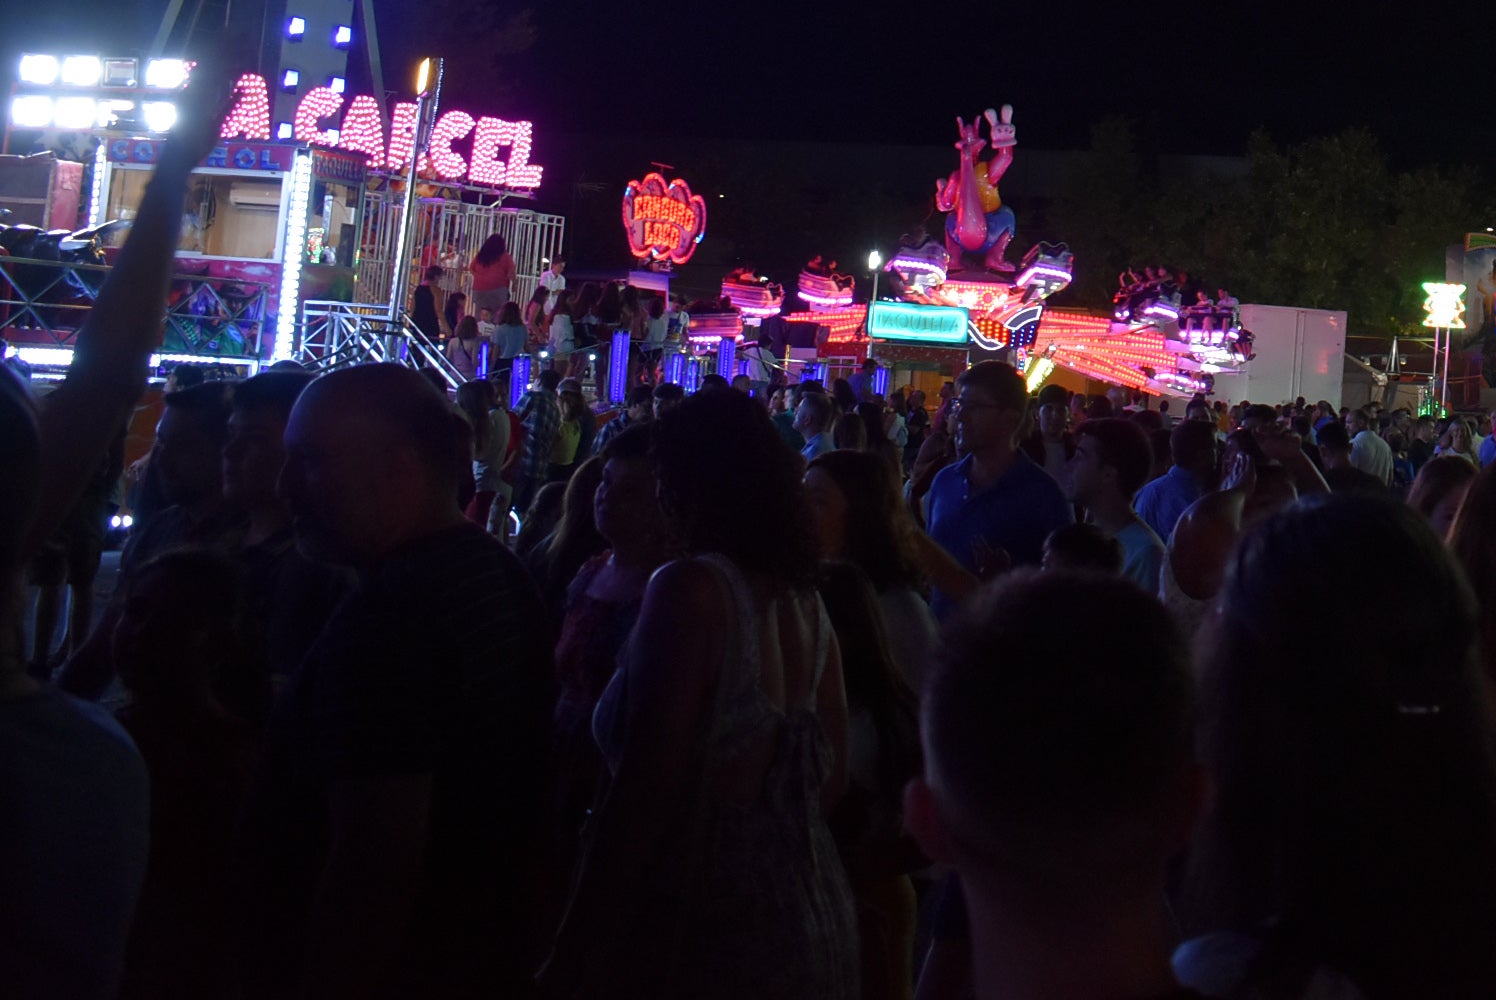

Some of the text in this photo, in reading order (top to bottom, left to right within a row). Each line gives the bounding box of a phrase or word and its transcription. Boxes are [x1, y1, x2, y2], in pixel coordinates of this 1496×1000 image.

[109, 137, 282, 173] COROL
[294, 86, 544, 189] CARCEL
[643, 221, 682, 250] LOCO
